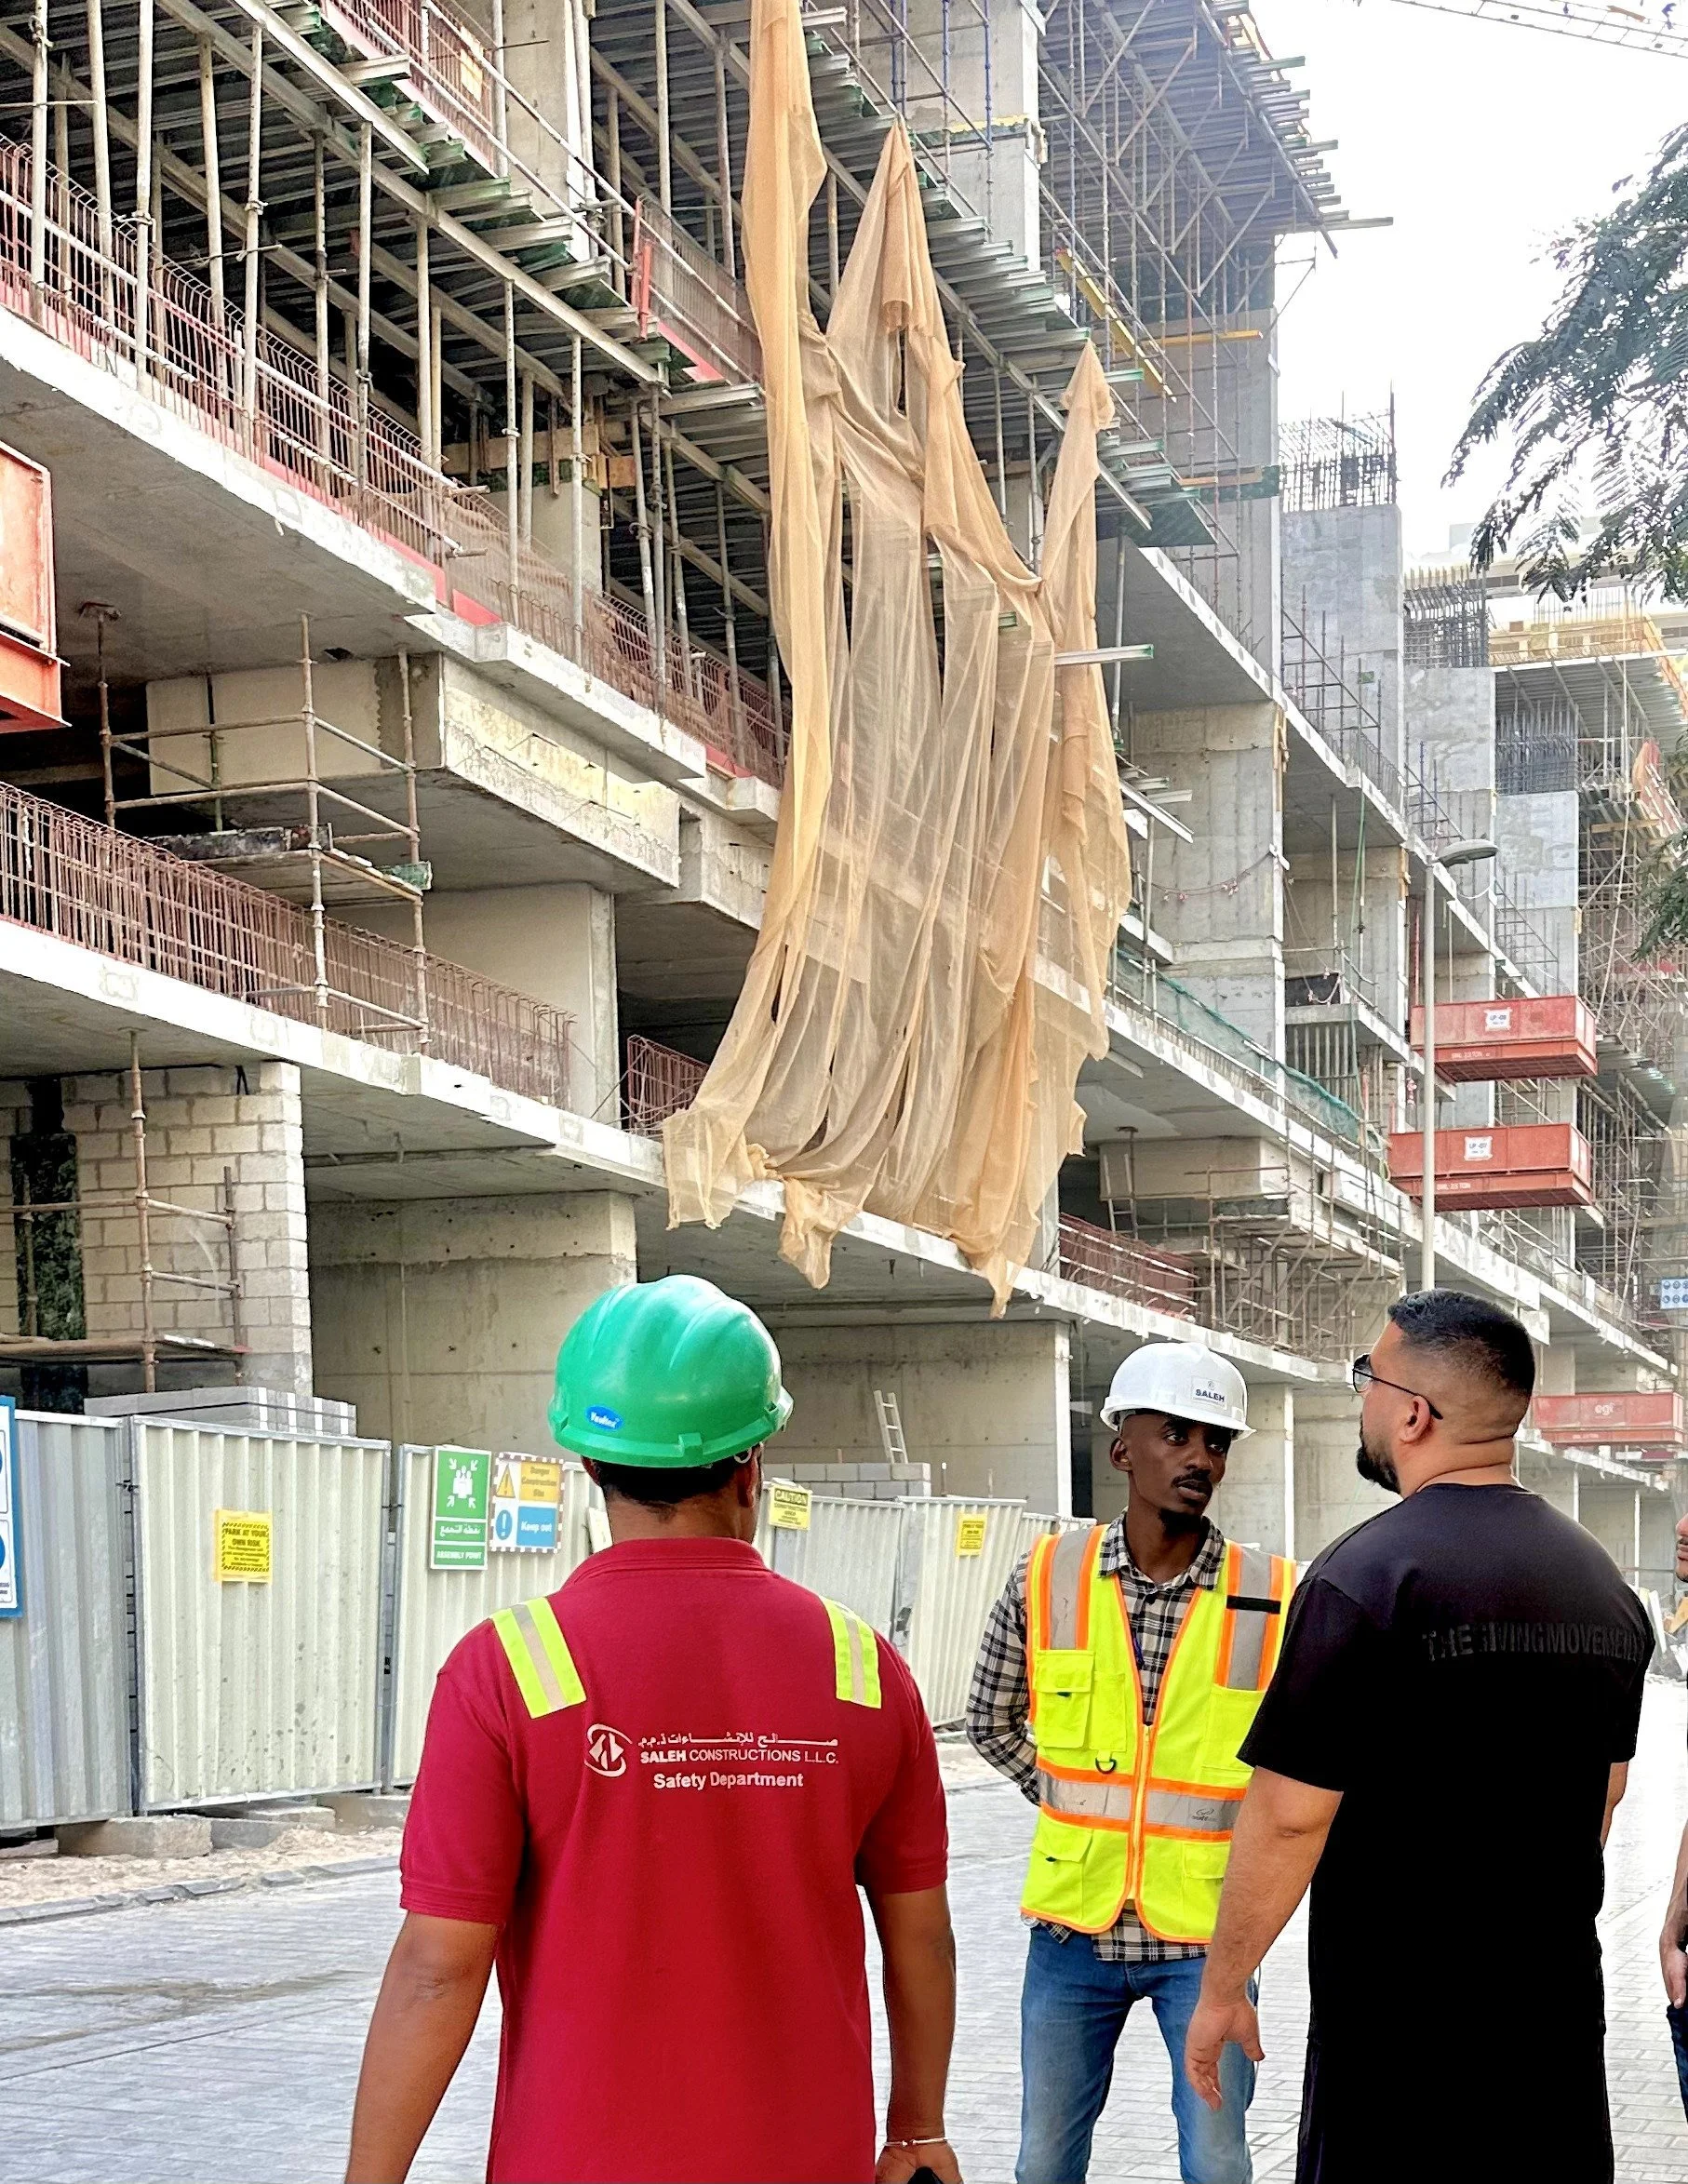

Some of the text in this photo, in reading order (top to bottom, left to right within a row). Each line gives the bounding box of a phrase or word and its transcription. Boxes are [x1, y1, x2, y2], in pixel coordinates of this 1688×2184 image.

[1195, 1388, 1226, 1402] SALEH
[775, 1490, 808, 1505] CAUTION
[521, 1521, 553, 1534] Keep out
[640, 1749, 687, 1764] SALEH
[689, 1749, 801, 1762] CONSTRUCTIONS
[653, 1771, 804, 1791] Safety Department
